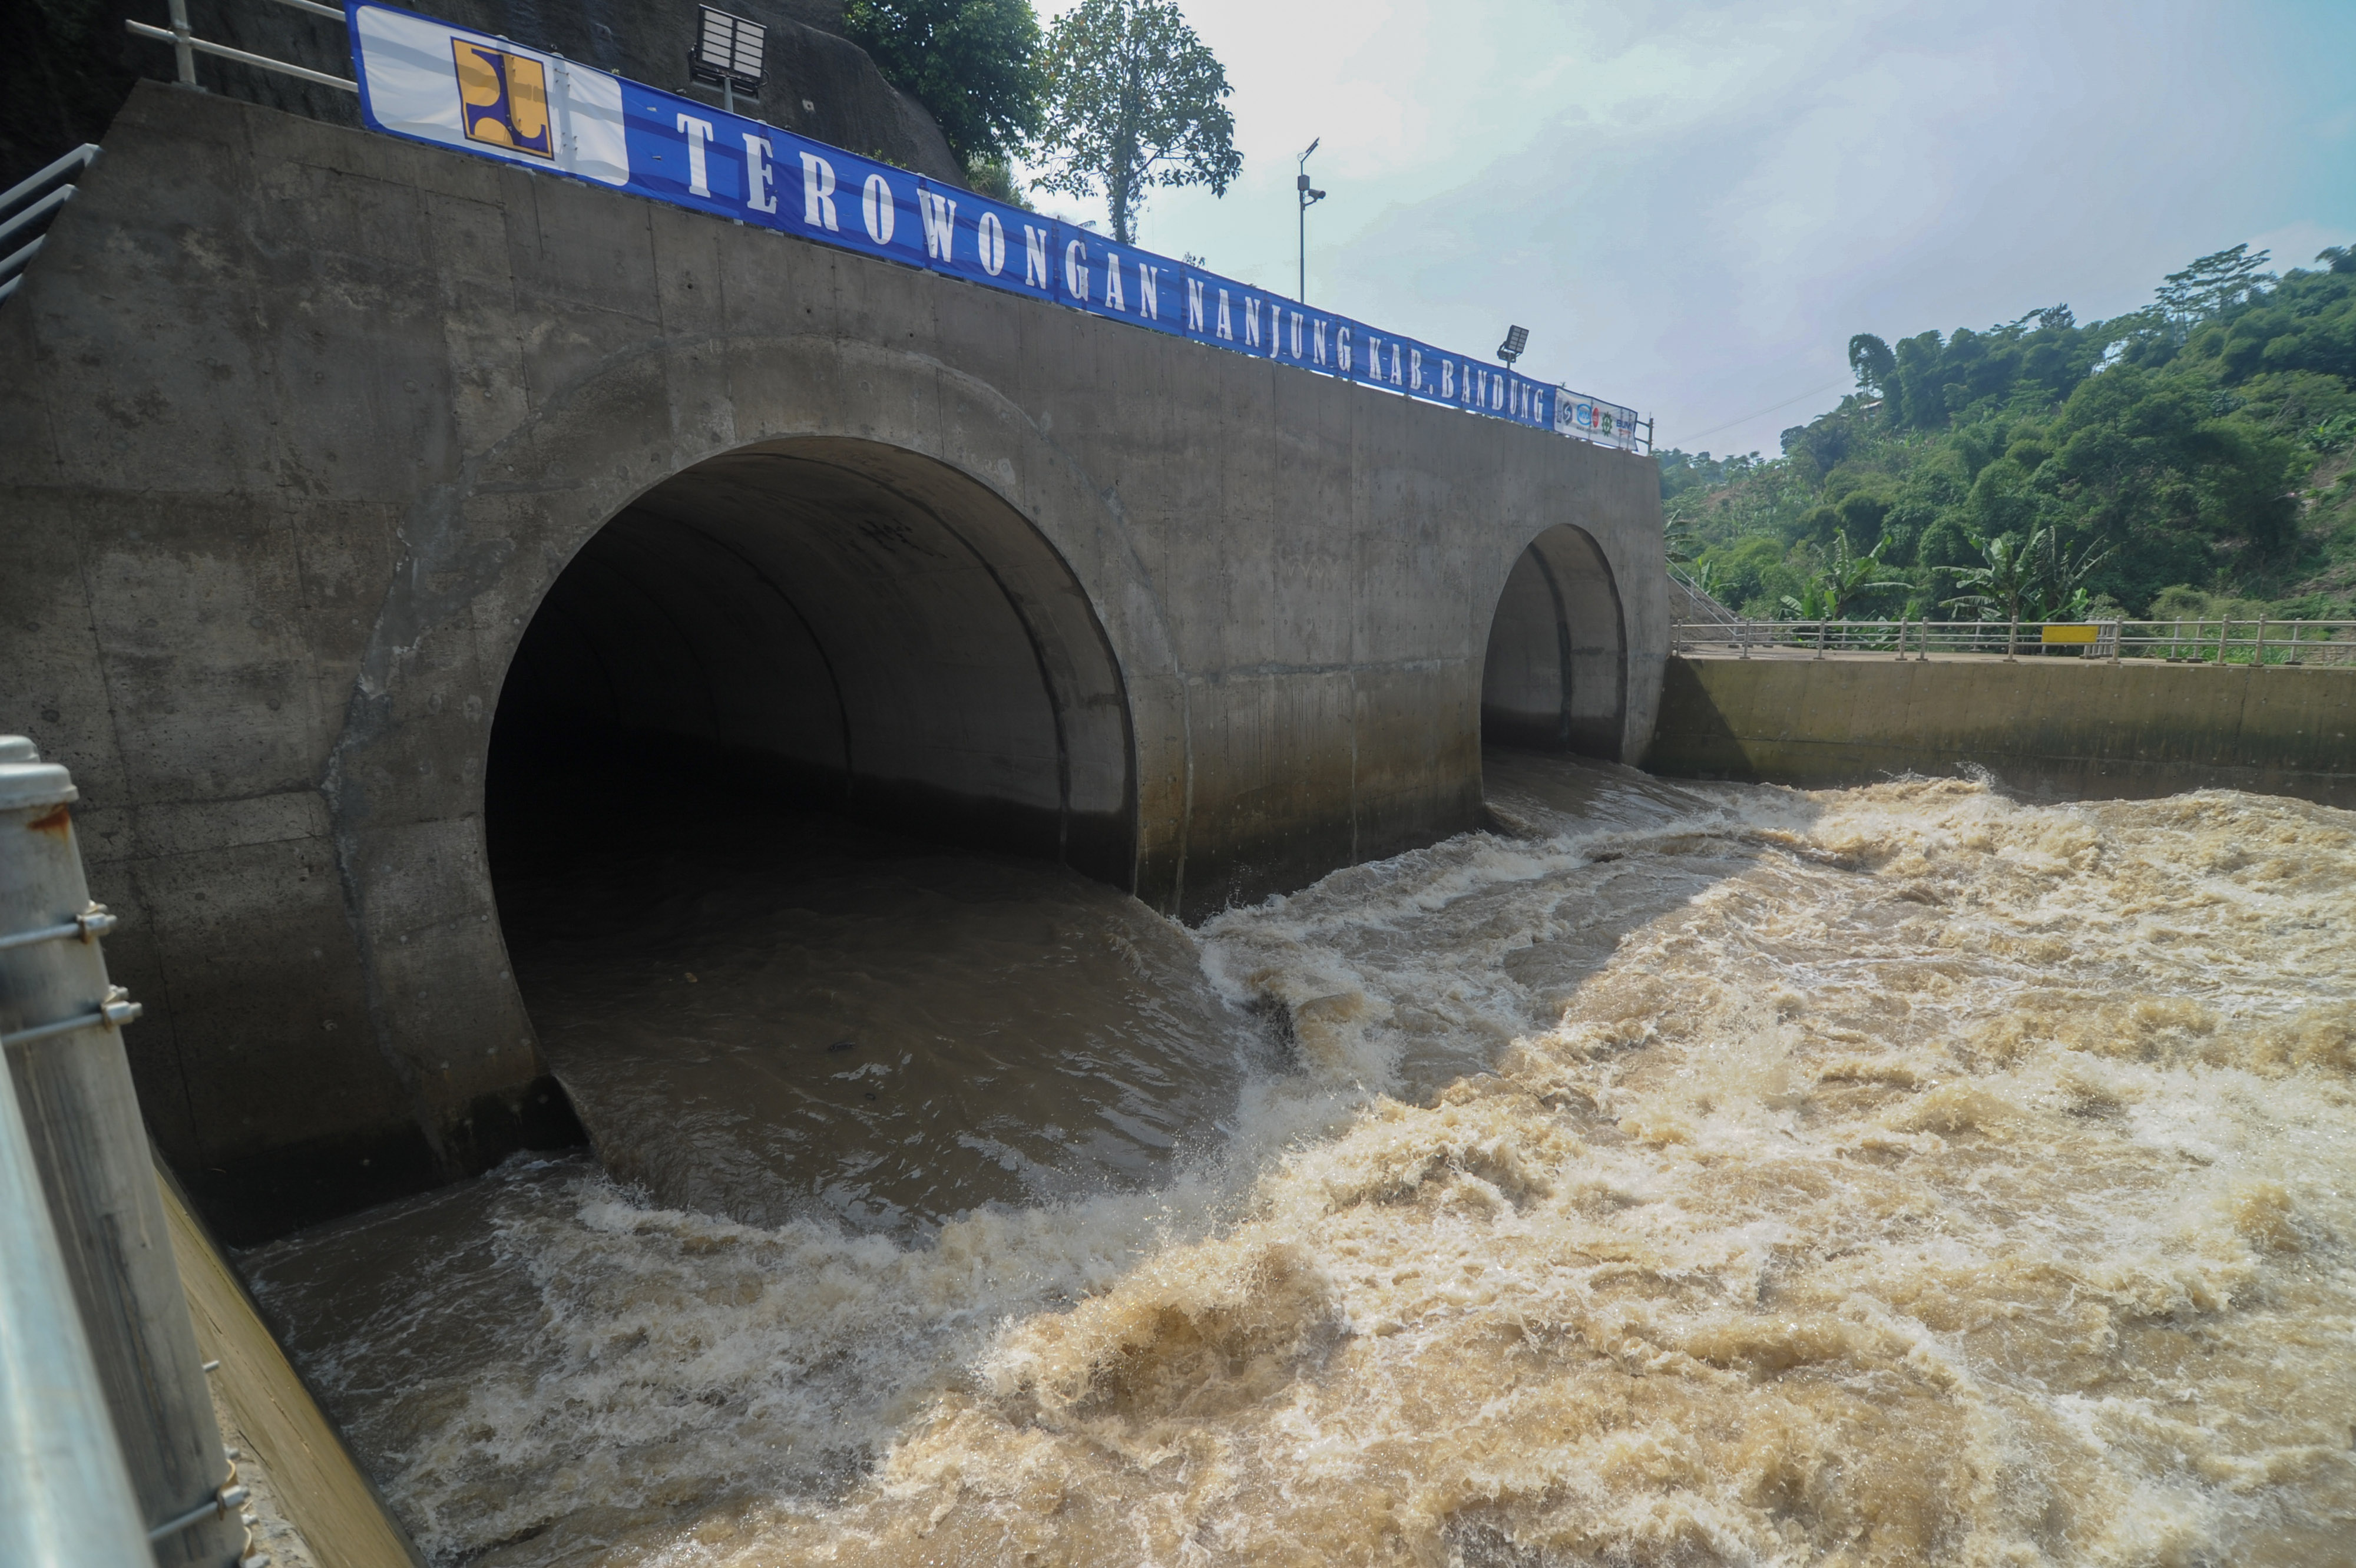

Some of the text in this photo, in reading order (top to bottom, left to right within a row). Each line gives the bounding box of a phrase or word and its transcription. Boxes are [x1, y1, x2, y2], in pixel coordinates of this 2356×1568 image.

[677, 113, 1544, 424] TEROWONGAN NANJUNG KAB. BANDUNG
